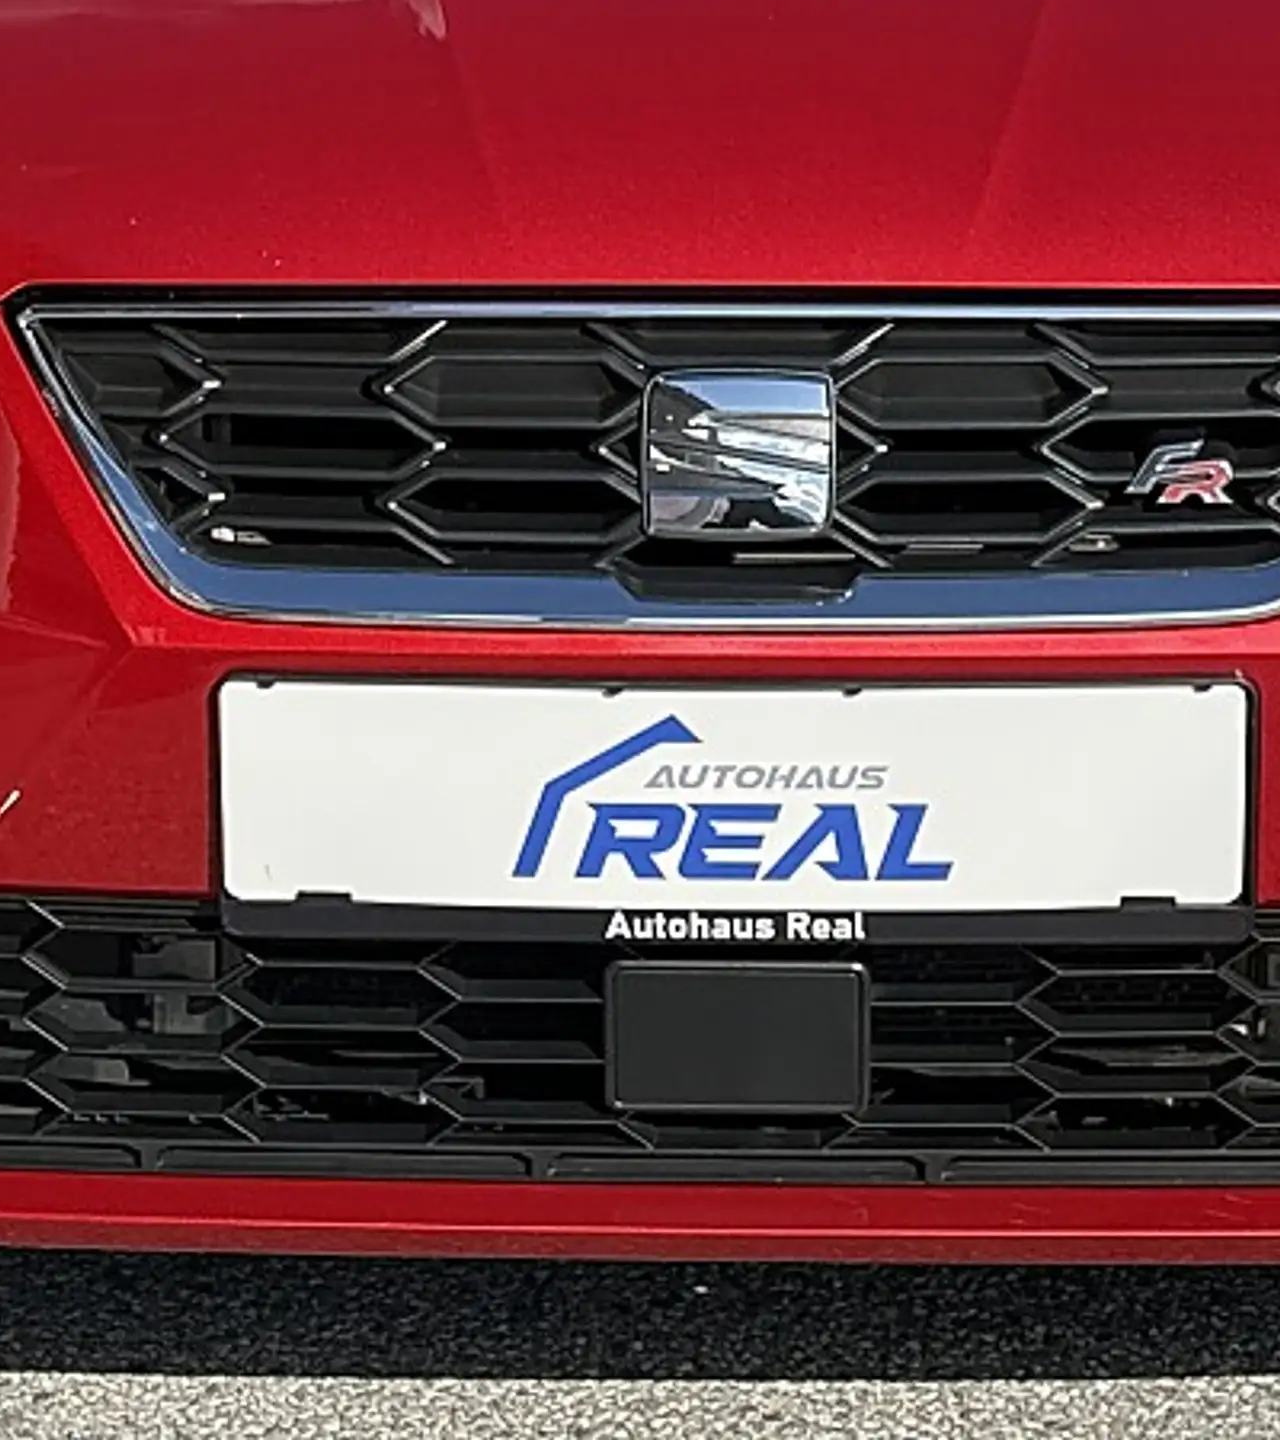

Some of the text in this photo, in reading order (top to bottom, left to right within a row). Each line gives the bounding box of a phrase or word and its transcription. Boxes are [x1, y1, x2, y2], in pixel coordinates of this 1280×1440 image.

[1123, 439, 1234, 505] FR
[643, 764, 888, 790] AUTOHAUS
[574, 802, 955, 881] REAL
[604, 911, 866, 941] Autohaus Real
